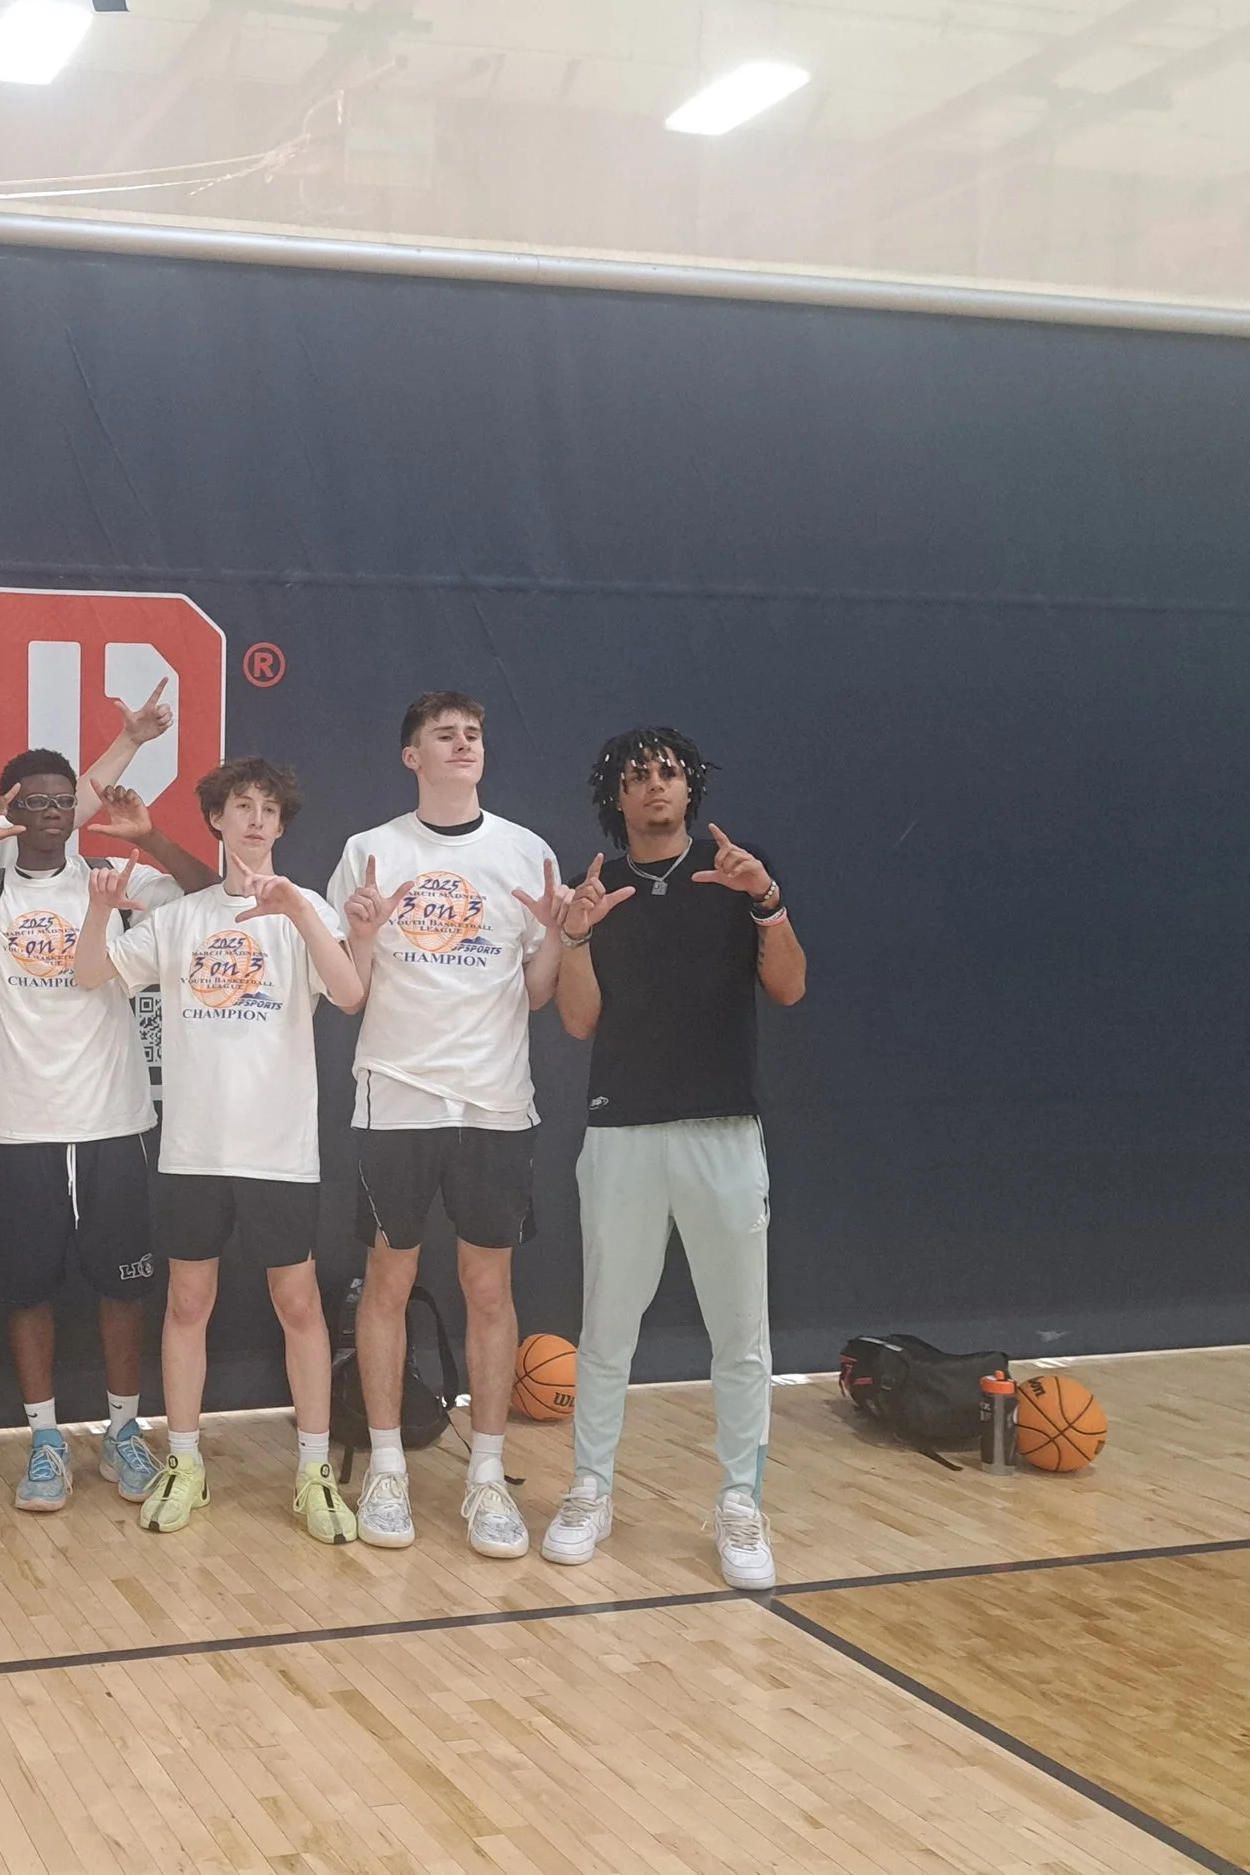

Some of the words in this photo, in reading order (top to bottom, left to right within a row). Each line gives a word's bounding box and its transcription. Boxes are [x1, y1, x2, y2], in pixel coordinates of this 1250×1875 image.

[419, 879, 461, 893] 2025
[398, 896, 417, 920] 3
[423, 903, 457, 919] on
[463, 900, 482, 922] 3
[18, 916, 56, 930] 2025
[25, 939, 55, 955] on
[62, 933, 76, 954] 3
[208, 937, 247, 952] 2025
[393, 951, 488, 967] CHAMPION
[190, 957, 206, 978] 3
[210, 962, 239, 977] on
[244, 957, 264, 978] 3
[182, 1008, 268, 1021] CHAMPION
